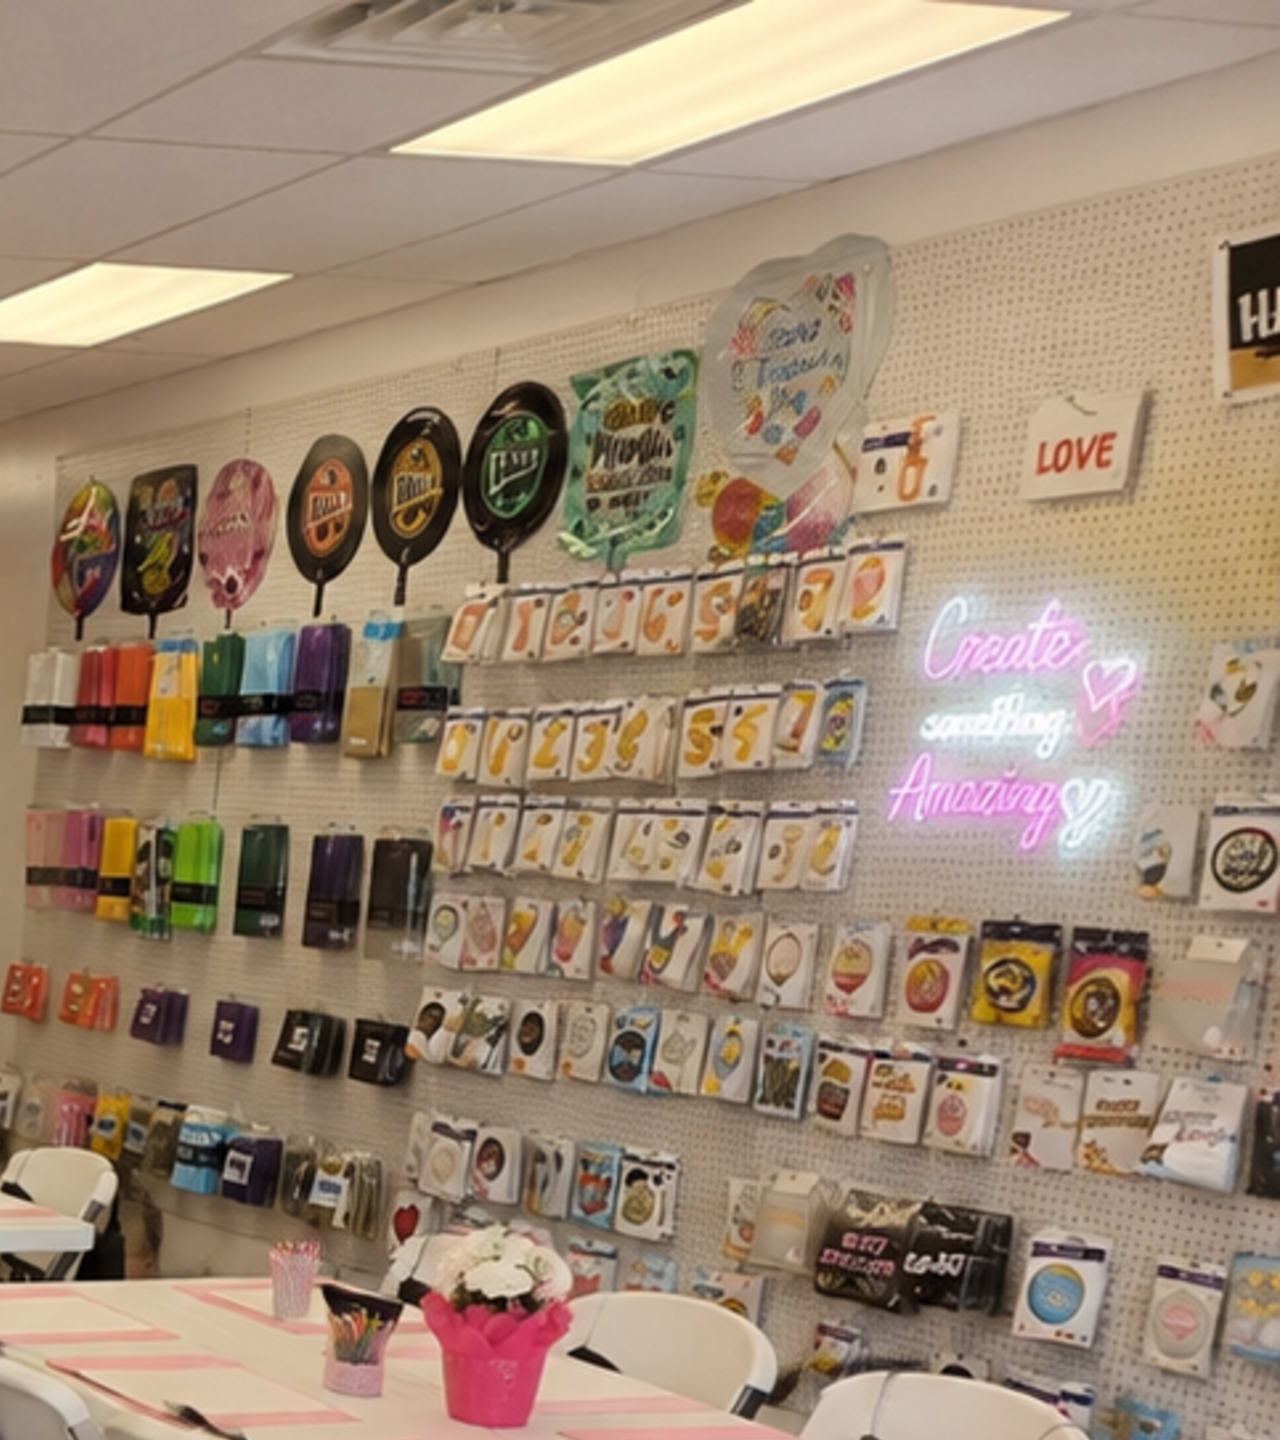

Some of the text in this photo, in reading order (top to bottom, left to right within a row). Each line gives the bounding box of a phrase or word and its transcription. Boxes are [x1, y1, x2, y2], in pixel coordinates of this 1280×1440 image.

[1035, 431, 1119, 476] LOVE
[923, 595, 1092, 680] Create
[887, 751, 1062, 850] Amazing
